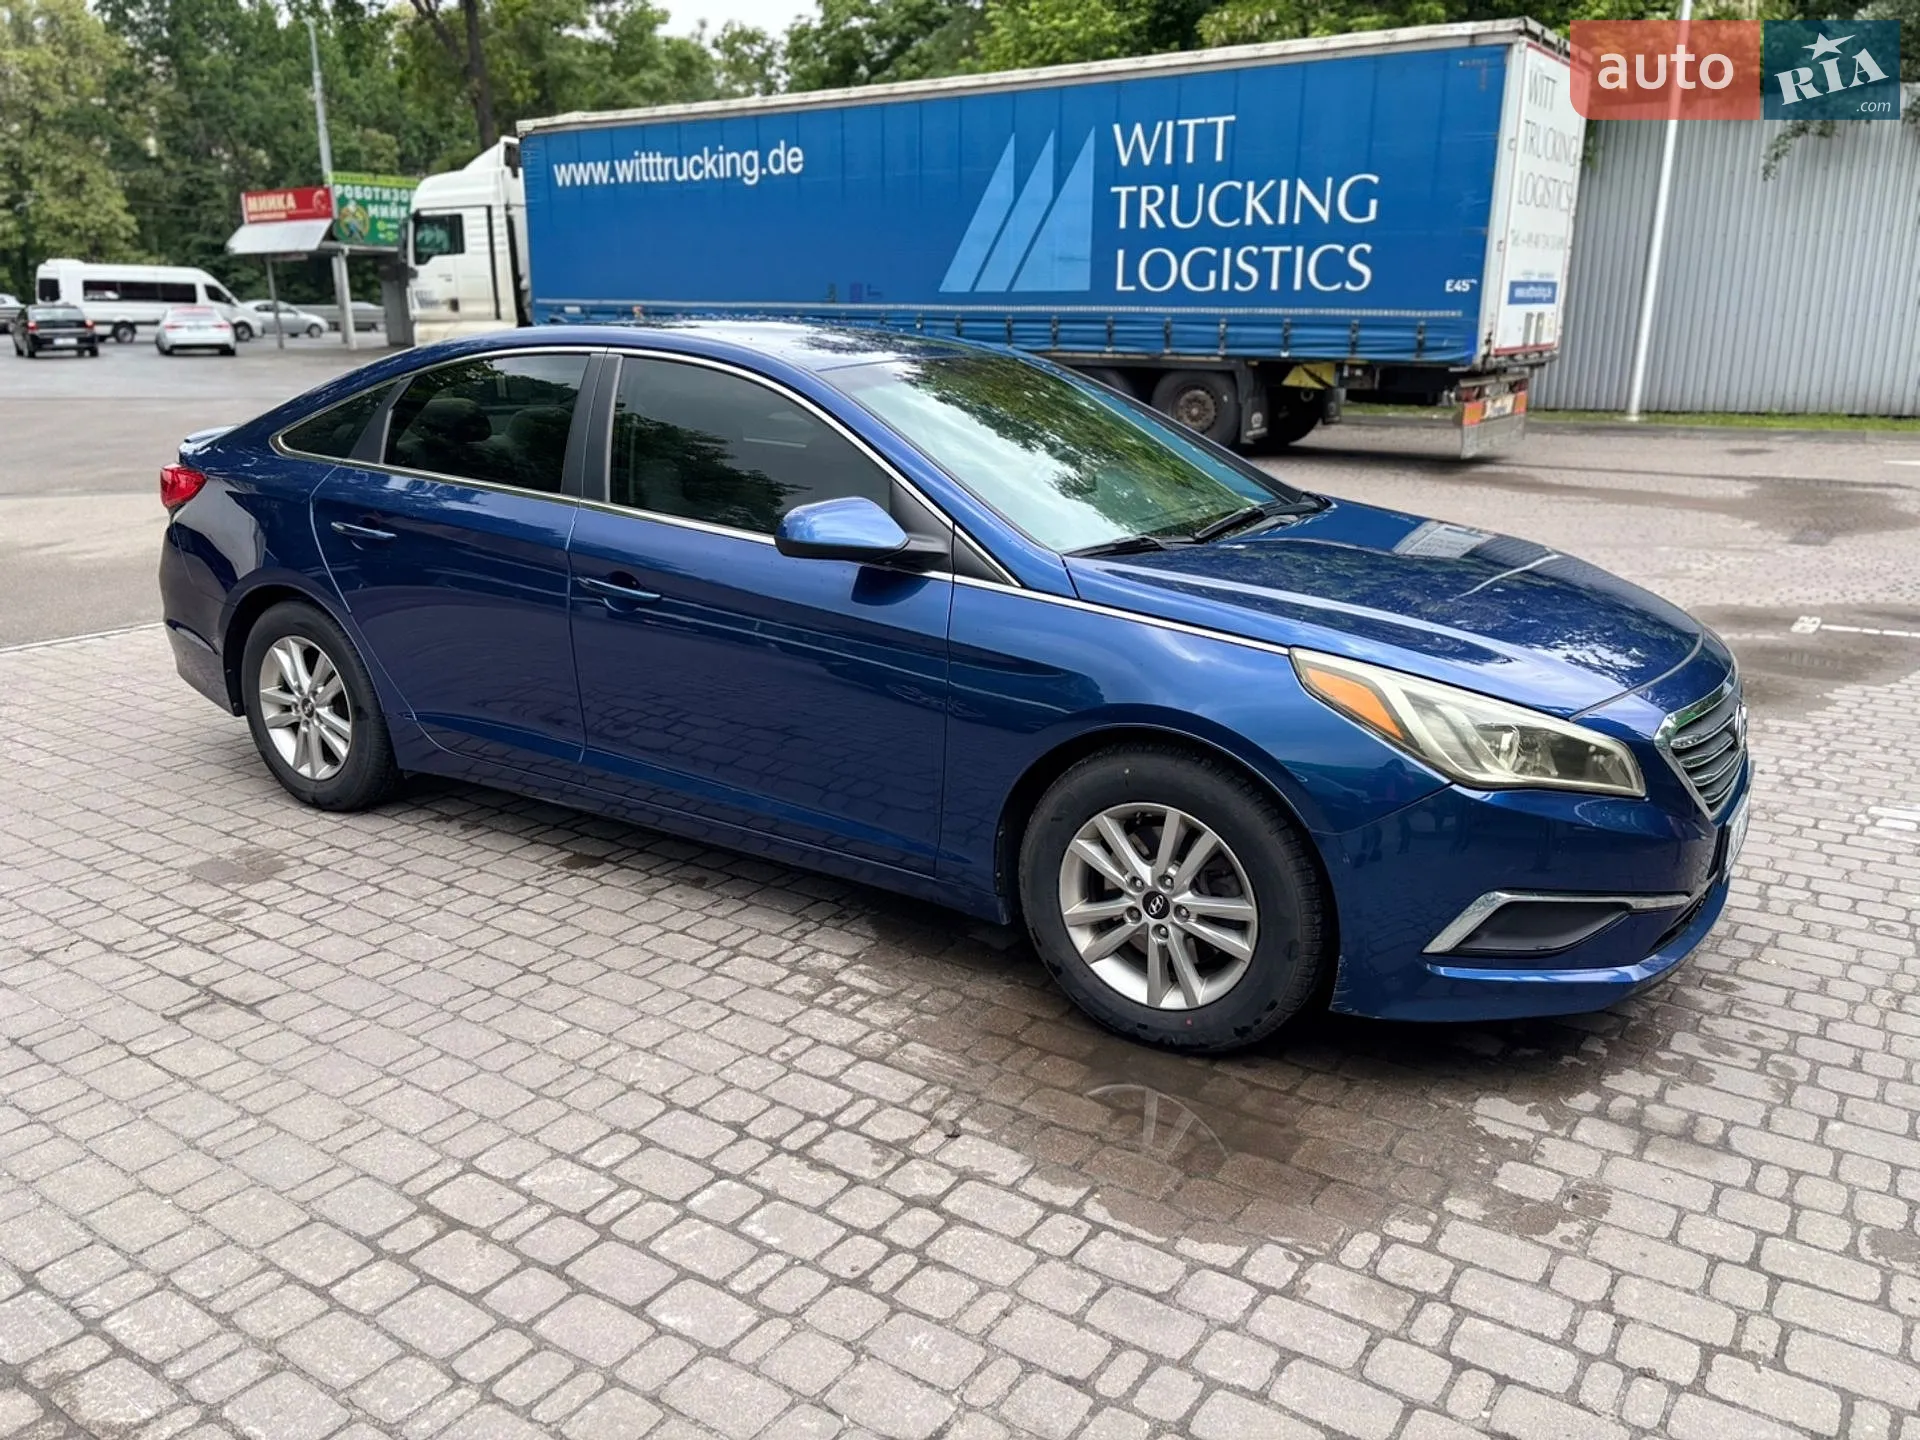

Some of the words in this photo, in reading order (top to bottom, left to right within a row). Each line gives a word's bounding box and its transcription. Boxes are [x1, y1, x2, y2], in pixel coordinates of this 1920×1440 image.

[1528, 68, 1558, 112] WITT
[553, 140, 804, 187] www.witttrucking.de
[1112, 115, 1236, 167] WITT
[1523, 119, 1578, 168] TRUCKING
[333, 184, 413, 203] РОБОТИЗО
[367, 202, 408, 219] МИЙК
[1110, 174, 1380, 229] TRUCKING
[1517, 169, 1573, 213] LOGISTICS
[1115, 244, 1373, 292] LOGISTICS
